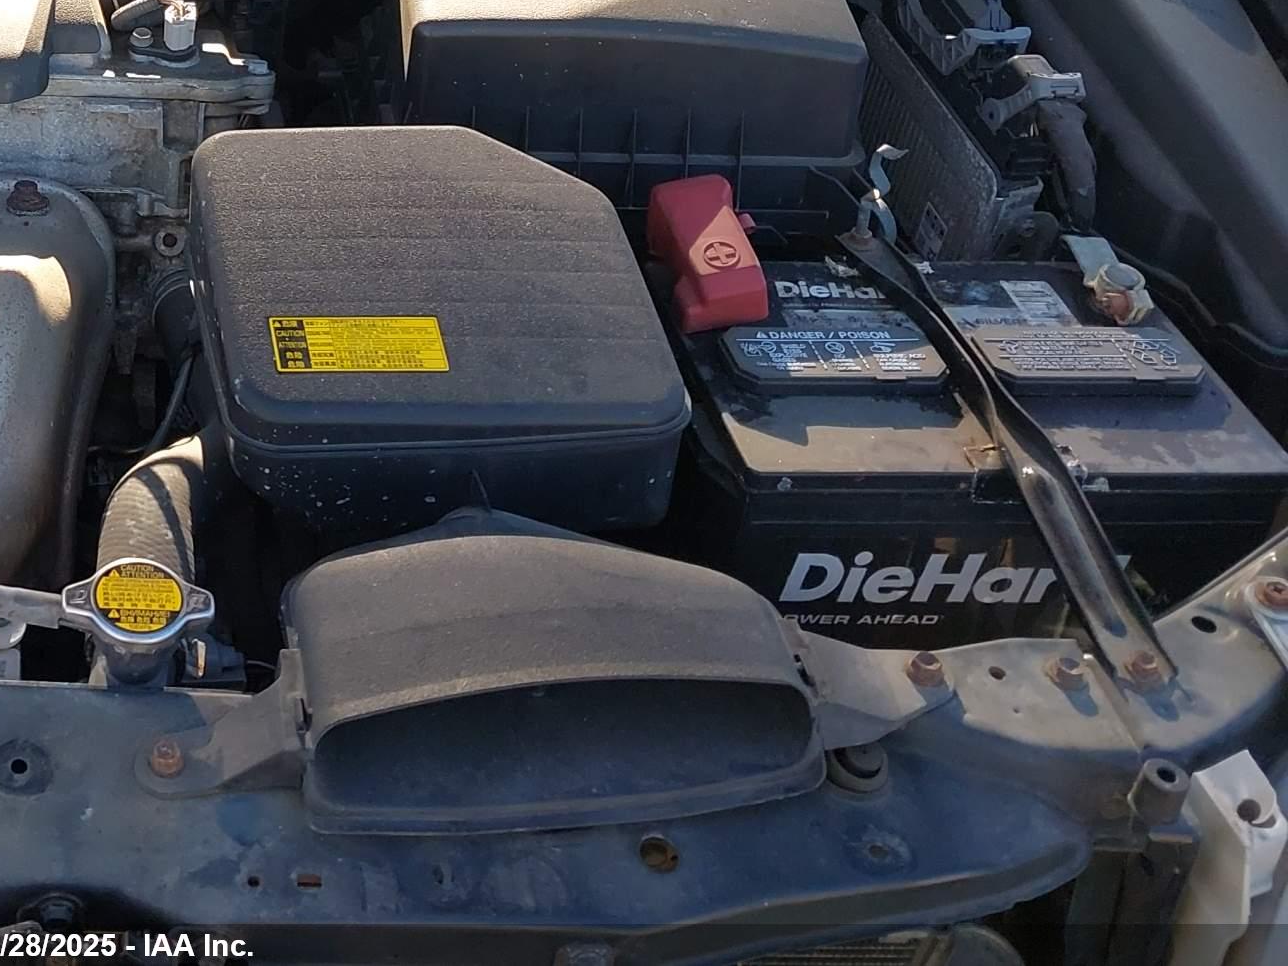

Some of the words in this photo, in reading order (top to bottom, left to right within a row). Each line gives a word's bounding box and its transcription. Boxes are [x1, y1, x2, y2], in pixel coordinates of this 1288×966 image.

[774, 281, 886, 299] DieHa
[768, 331, 825, 339] DANGER
[838, 331, 891, 339] POISON
[120, 564, 154, 572] CAUTION
[120, 571, 165, 579] ATTENTION
[779, 551, 1130, 604] DieHar
[782, 614, 850, 625] OWER
[856, 614, 939, 625] AHEAD
